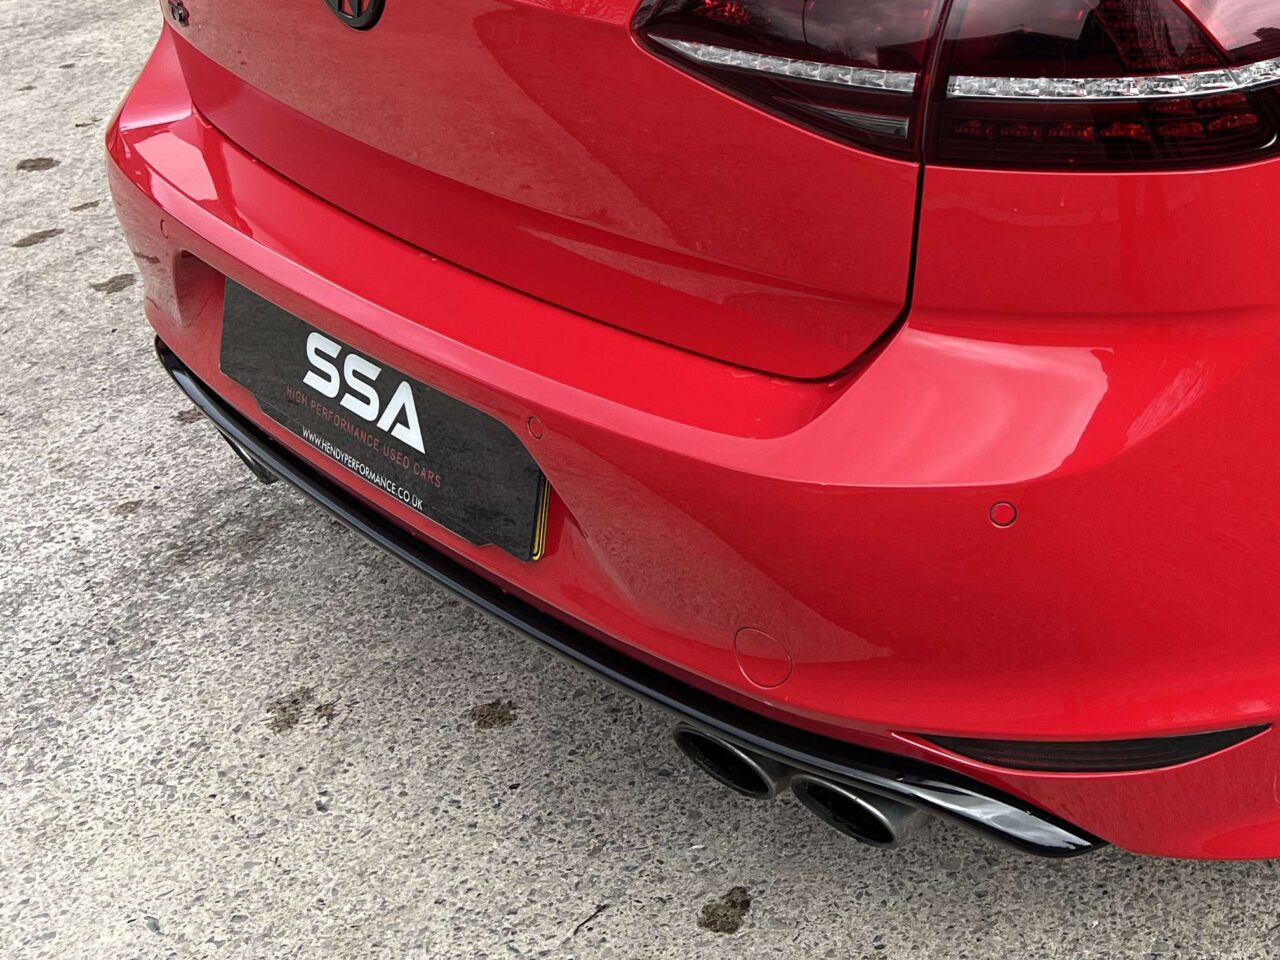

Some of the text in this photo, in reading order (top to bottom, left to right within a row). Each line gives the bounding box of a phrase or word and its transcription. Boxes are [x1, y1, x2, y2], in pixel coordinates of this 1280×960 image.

[286, 385, 442, 489] HIGH PERFORMANCE USED CARS
[302, 331, 426, 455] SSA
[302, 426, 424, 511] WWW.HENDYPERFORMANCE.CO.UK
